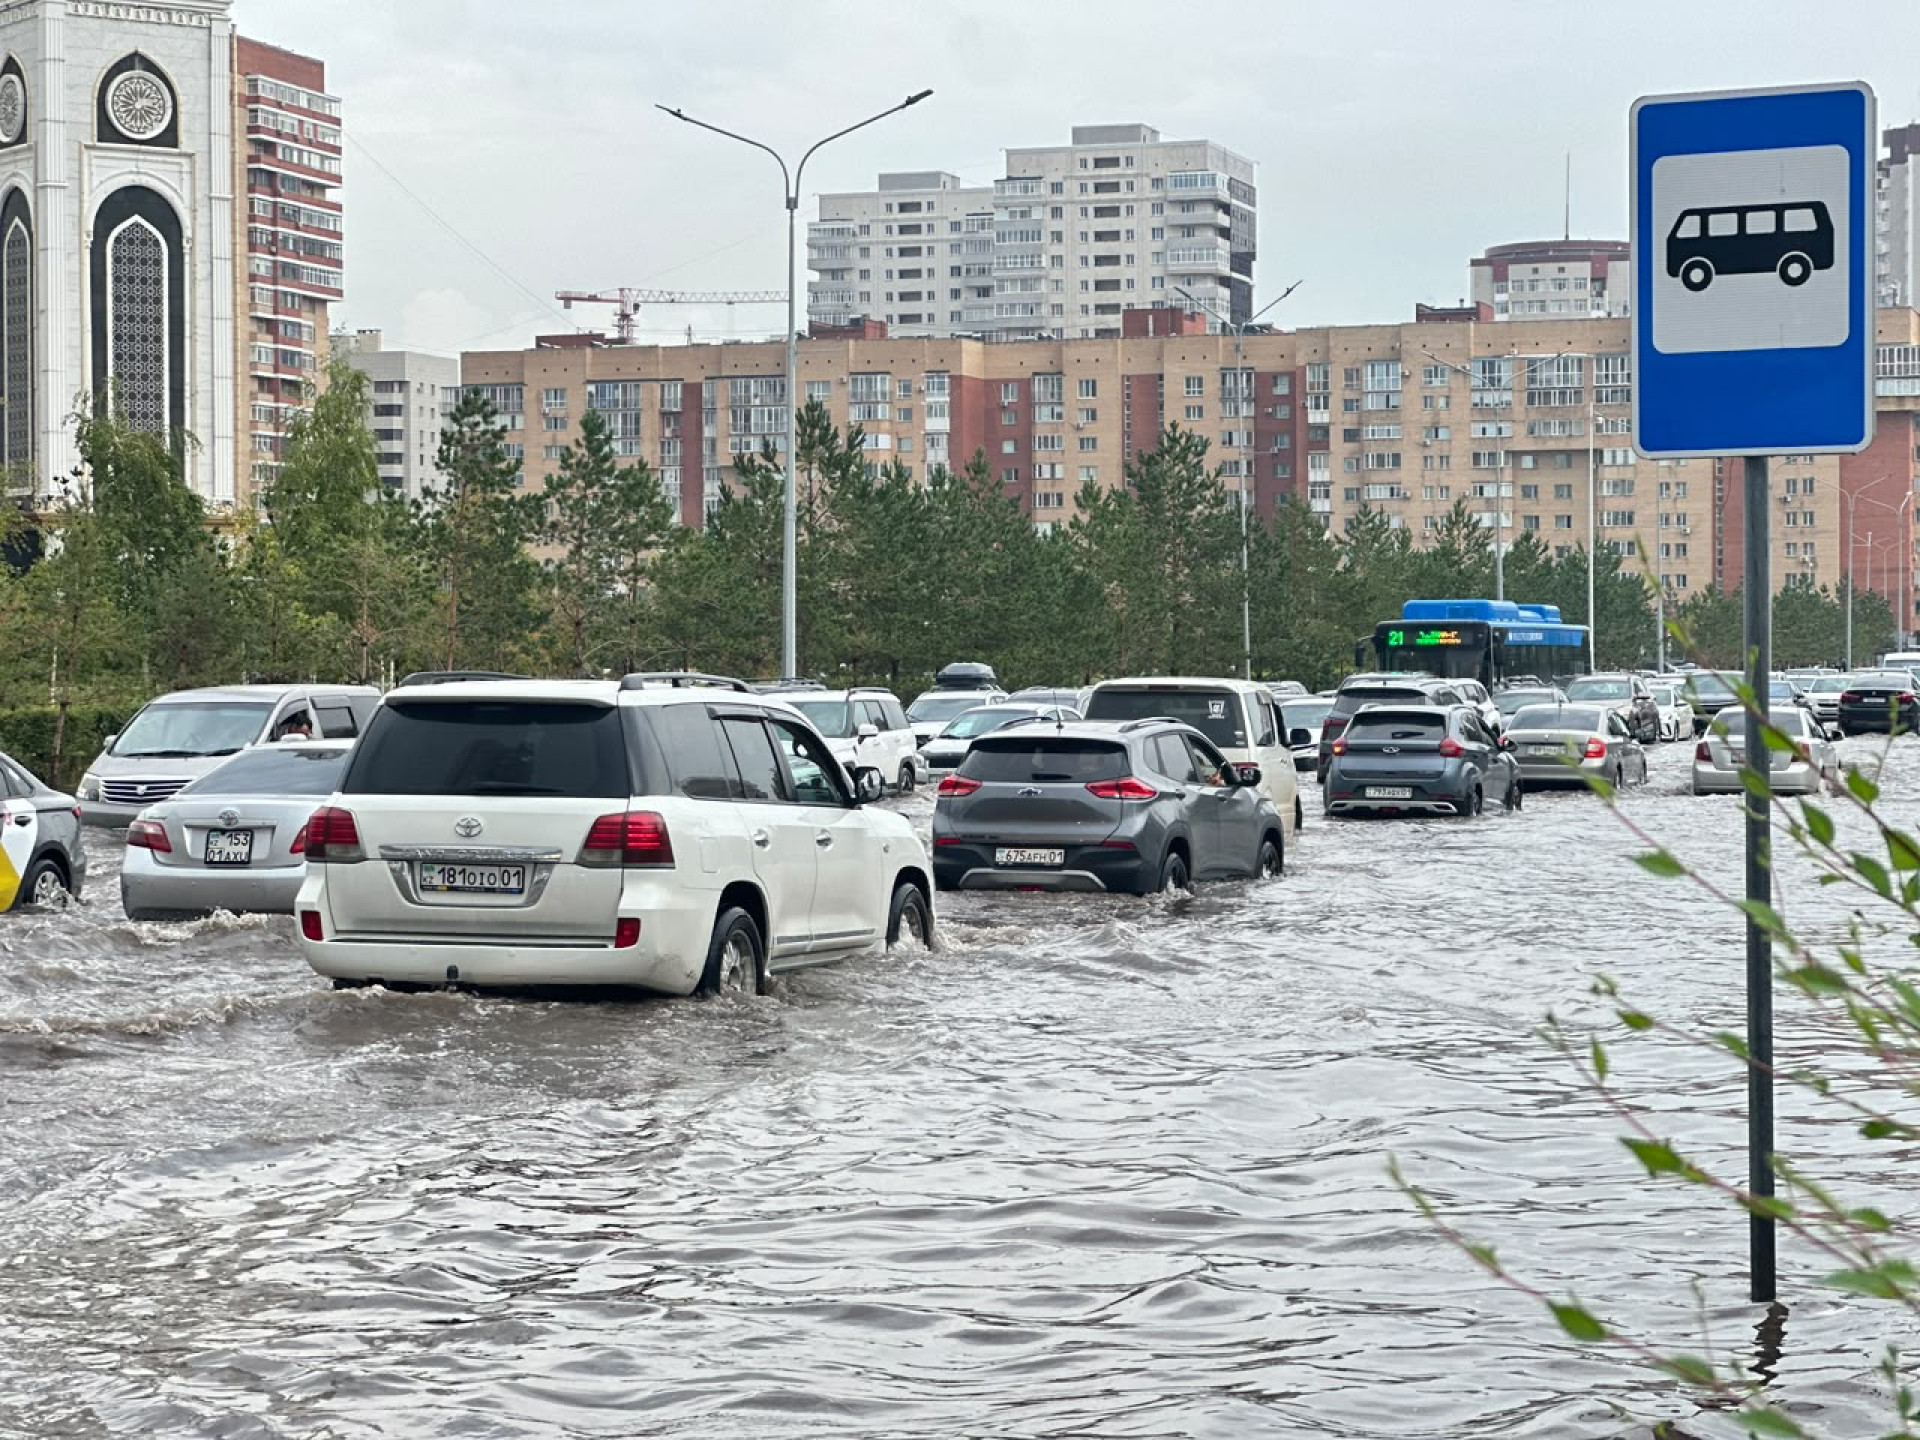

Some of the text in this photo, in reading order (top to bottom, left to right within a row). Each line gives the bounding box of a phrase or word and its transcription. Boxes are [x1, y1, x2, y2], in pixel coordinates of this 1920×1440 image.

[1388, 630, 1404, 646] 21
[226, 833, 250, 846] 153
[501, 869, 522, 887] 01
